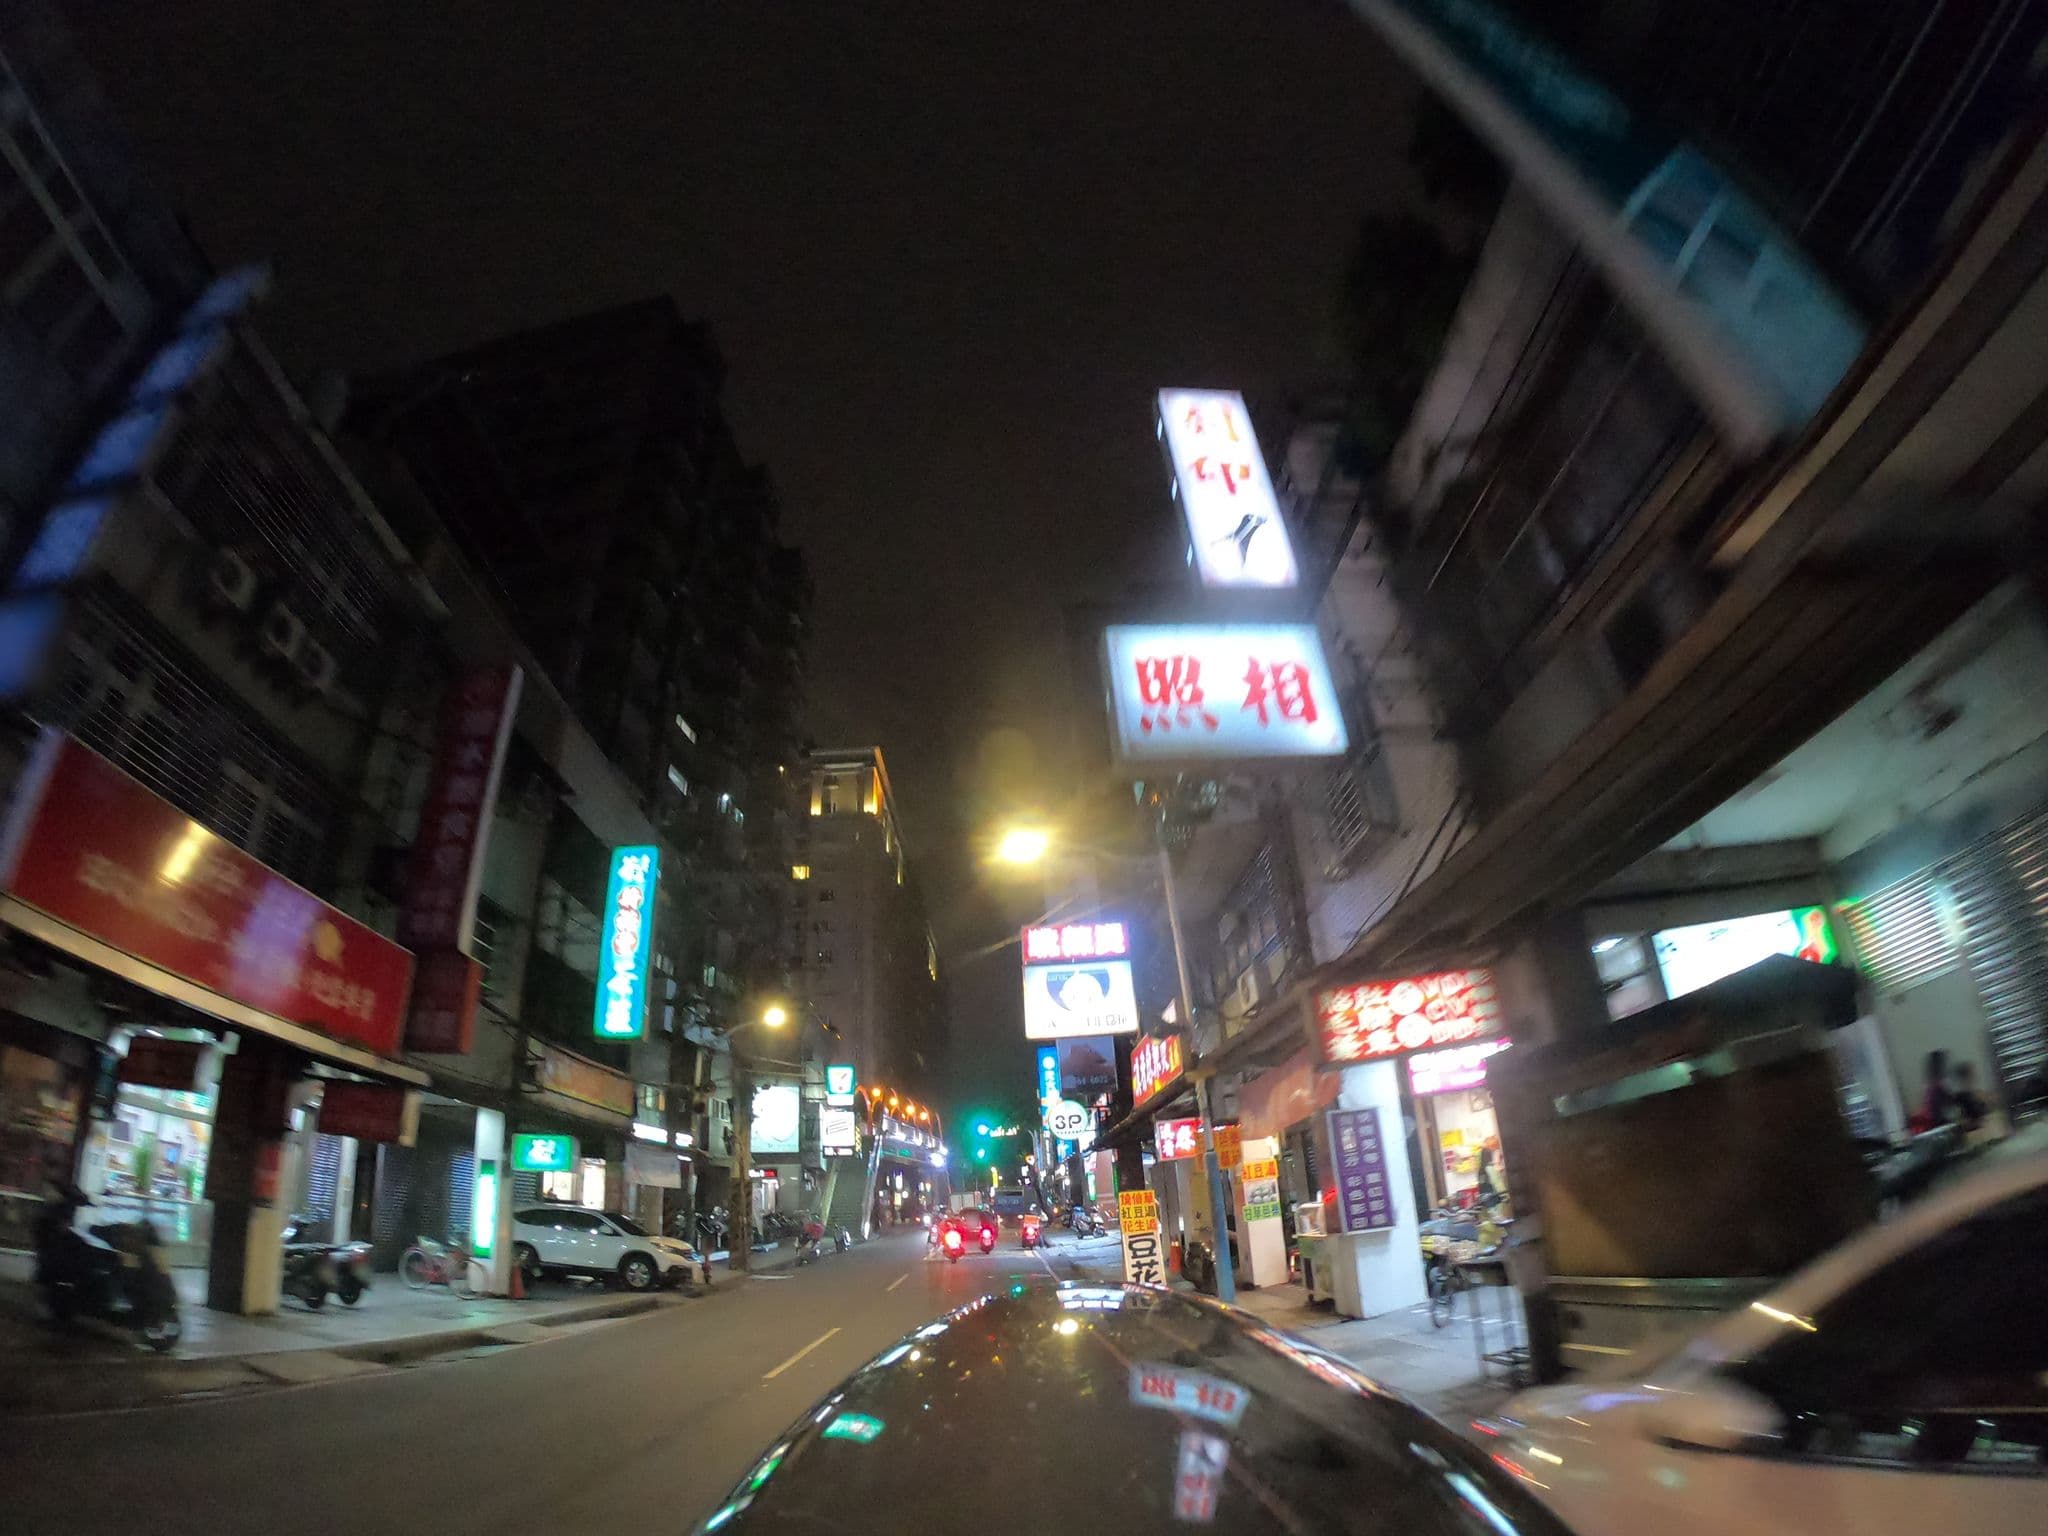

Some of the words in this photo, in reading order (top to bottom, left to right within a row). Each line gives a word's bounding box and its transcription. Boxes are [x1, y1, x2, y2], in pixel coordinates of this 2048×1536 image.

[1135, 655, 1318, 733] 照相
[1055, 1114, 1082, 1130] 3P
[1128, 1232, 1162, 1284] 豆花
